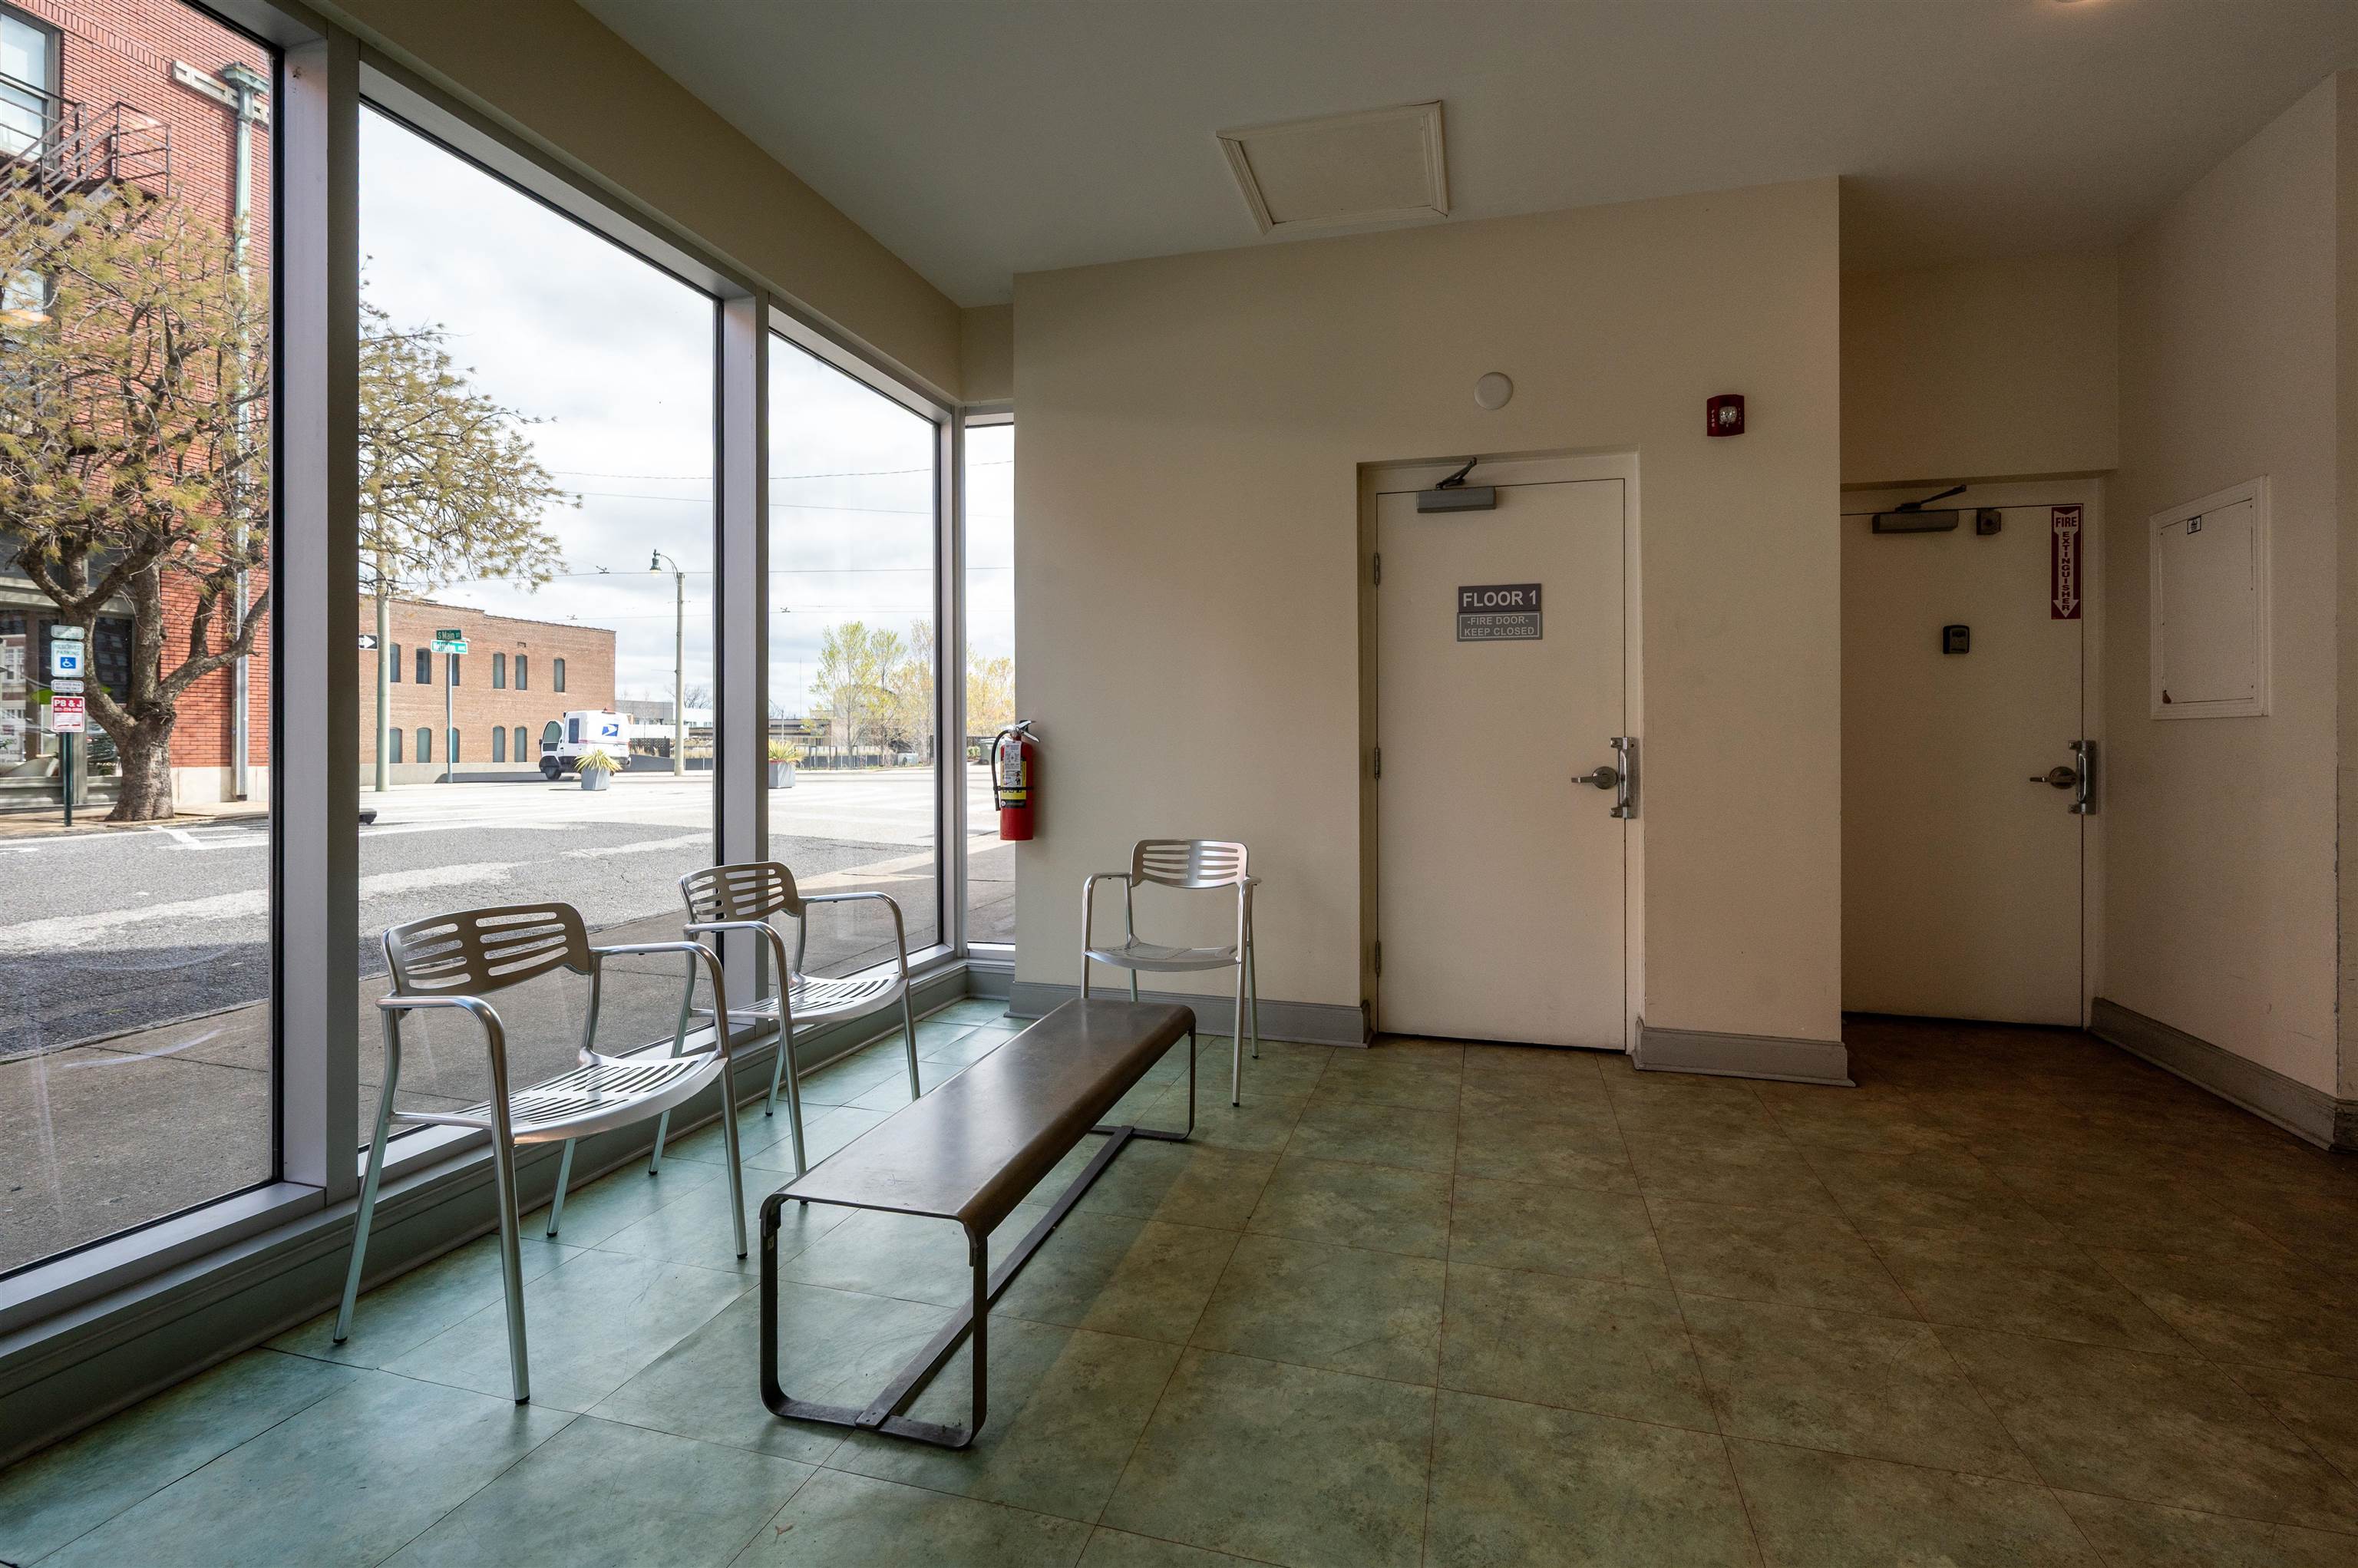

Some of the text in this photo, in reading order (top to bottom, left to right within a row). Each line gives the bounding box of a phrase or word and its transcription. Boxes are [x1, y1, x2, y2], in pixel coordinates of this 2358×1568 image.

[2056, 517, 2077, 527] FIRE
[2062, 532, 2070, 611] EXTINGUISHER
[1463, 590, 1536, 607] FLOOR 1
[442, 631, 454, 639] Main
[1464, 626, 1534, 636] KEEP CLOSED
